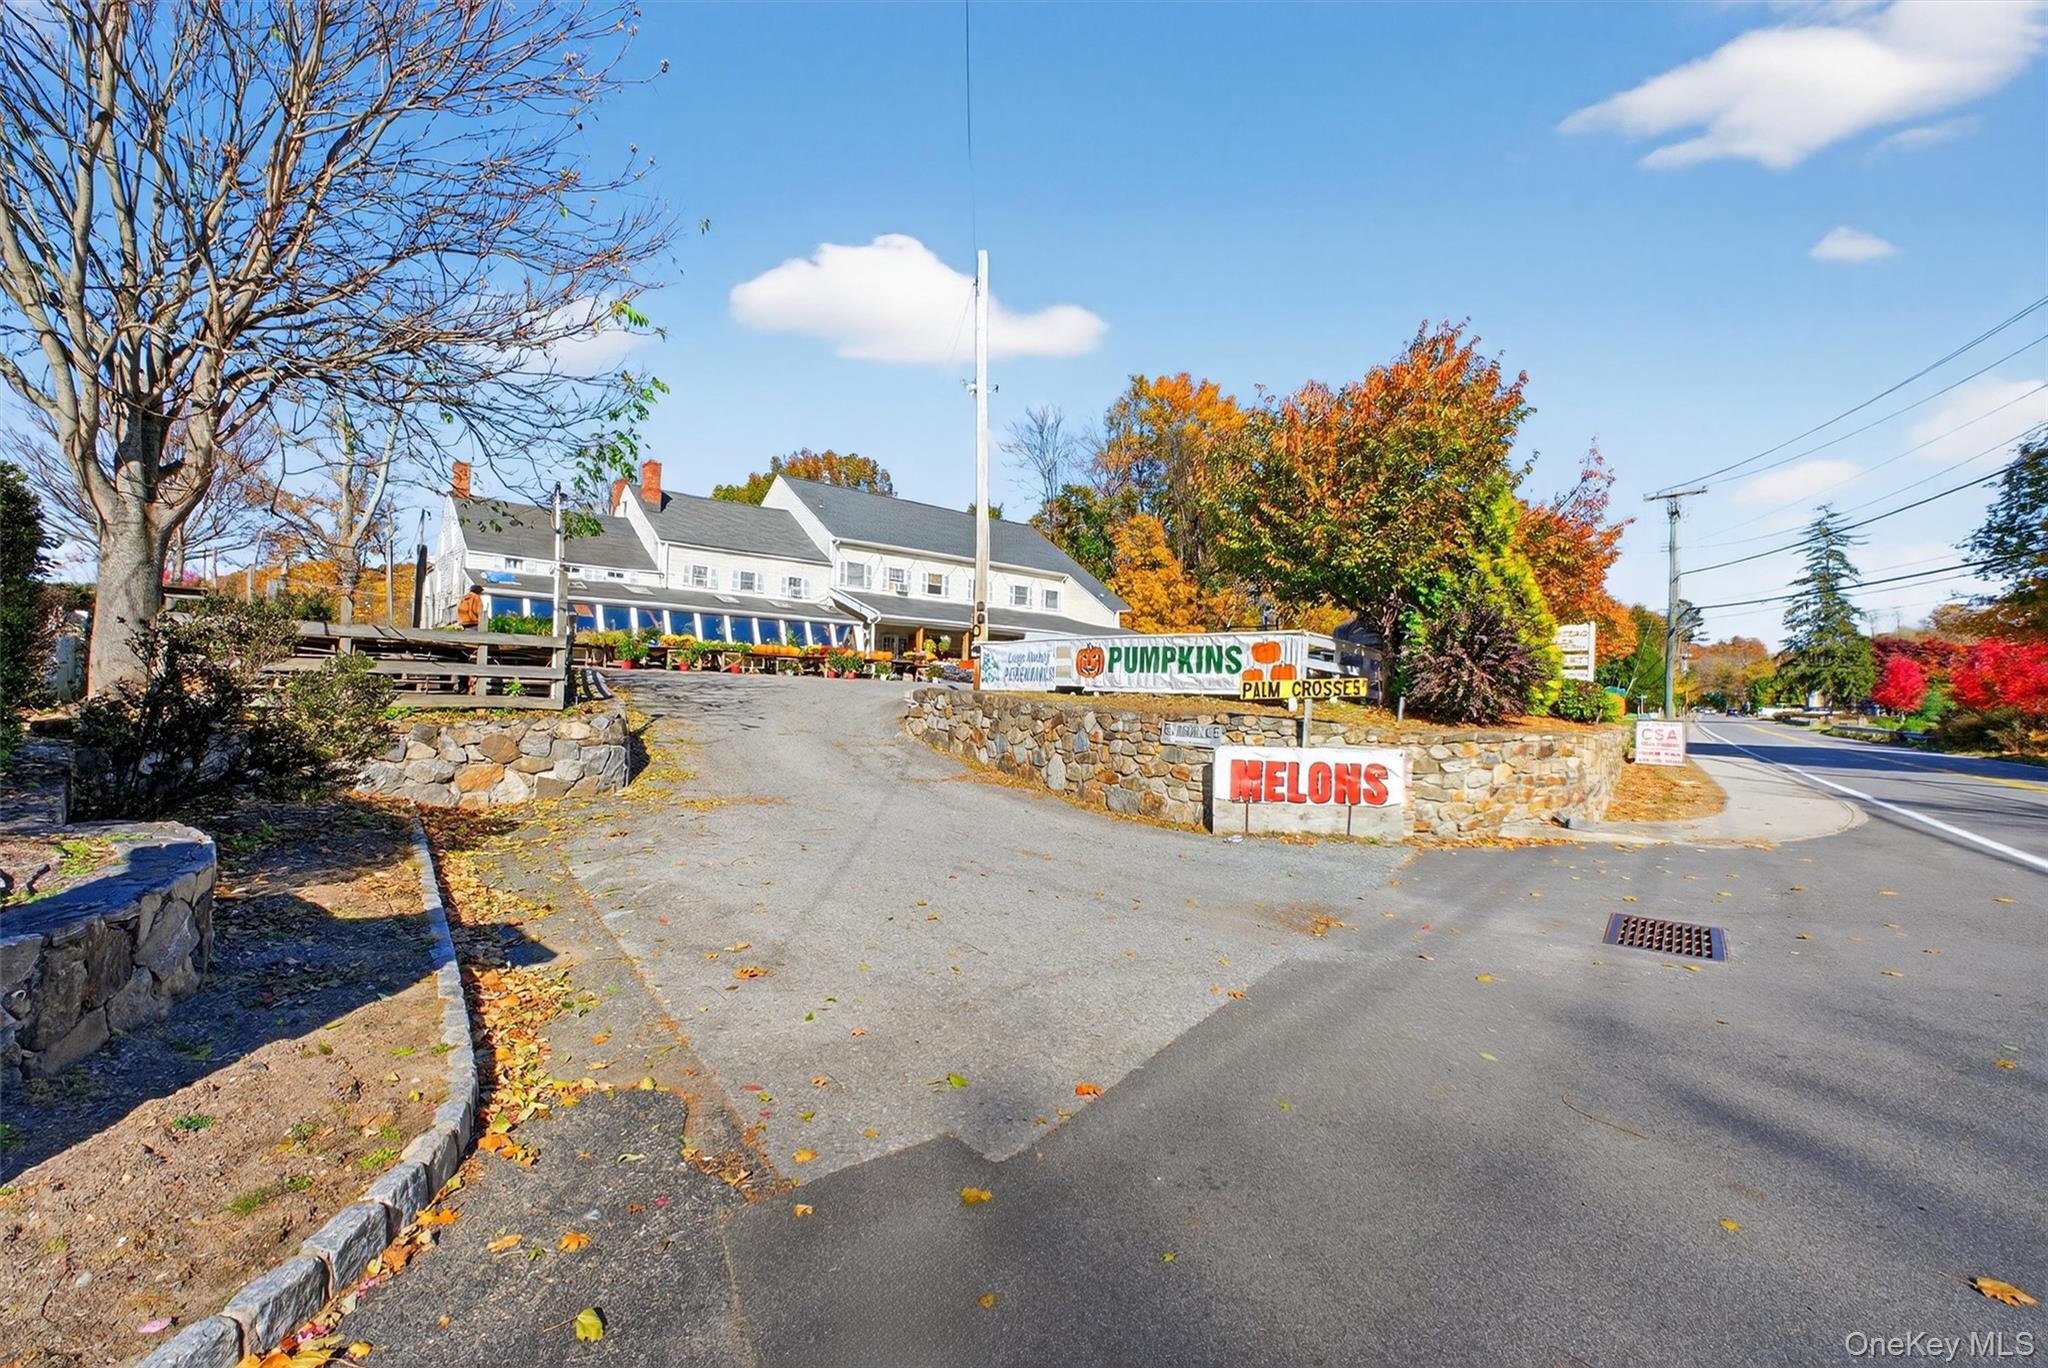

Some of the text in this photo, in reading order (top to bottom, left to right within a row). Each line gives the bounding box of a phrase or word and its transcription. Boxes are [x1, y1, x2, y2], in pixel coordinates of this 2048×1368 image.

[1107, 645, 1243, 675] PUMPKINS
[1242, 679, 1361, 699] PALM CROSSES
[1641, 728, 1677, 741] CSA
[1230, 759, 1389, 806] MELONS
